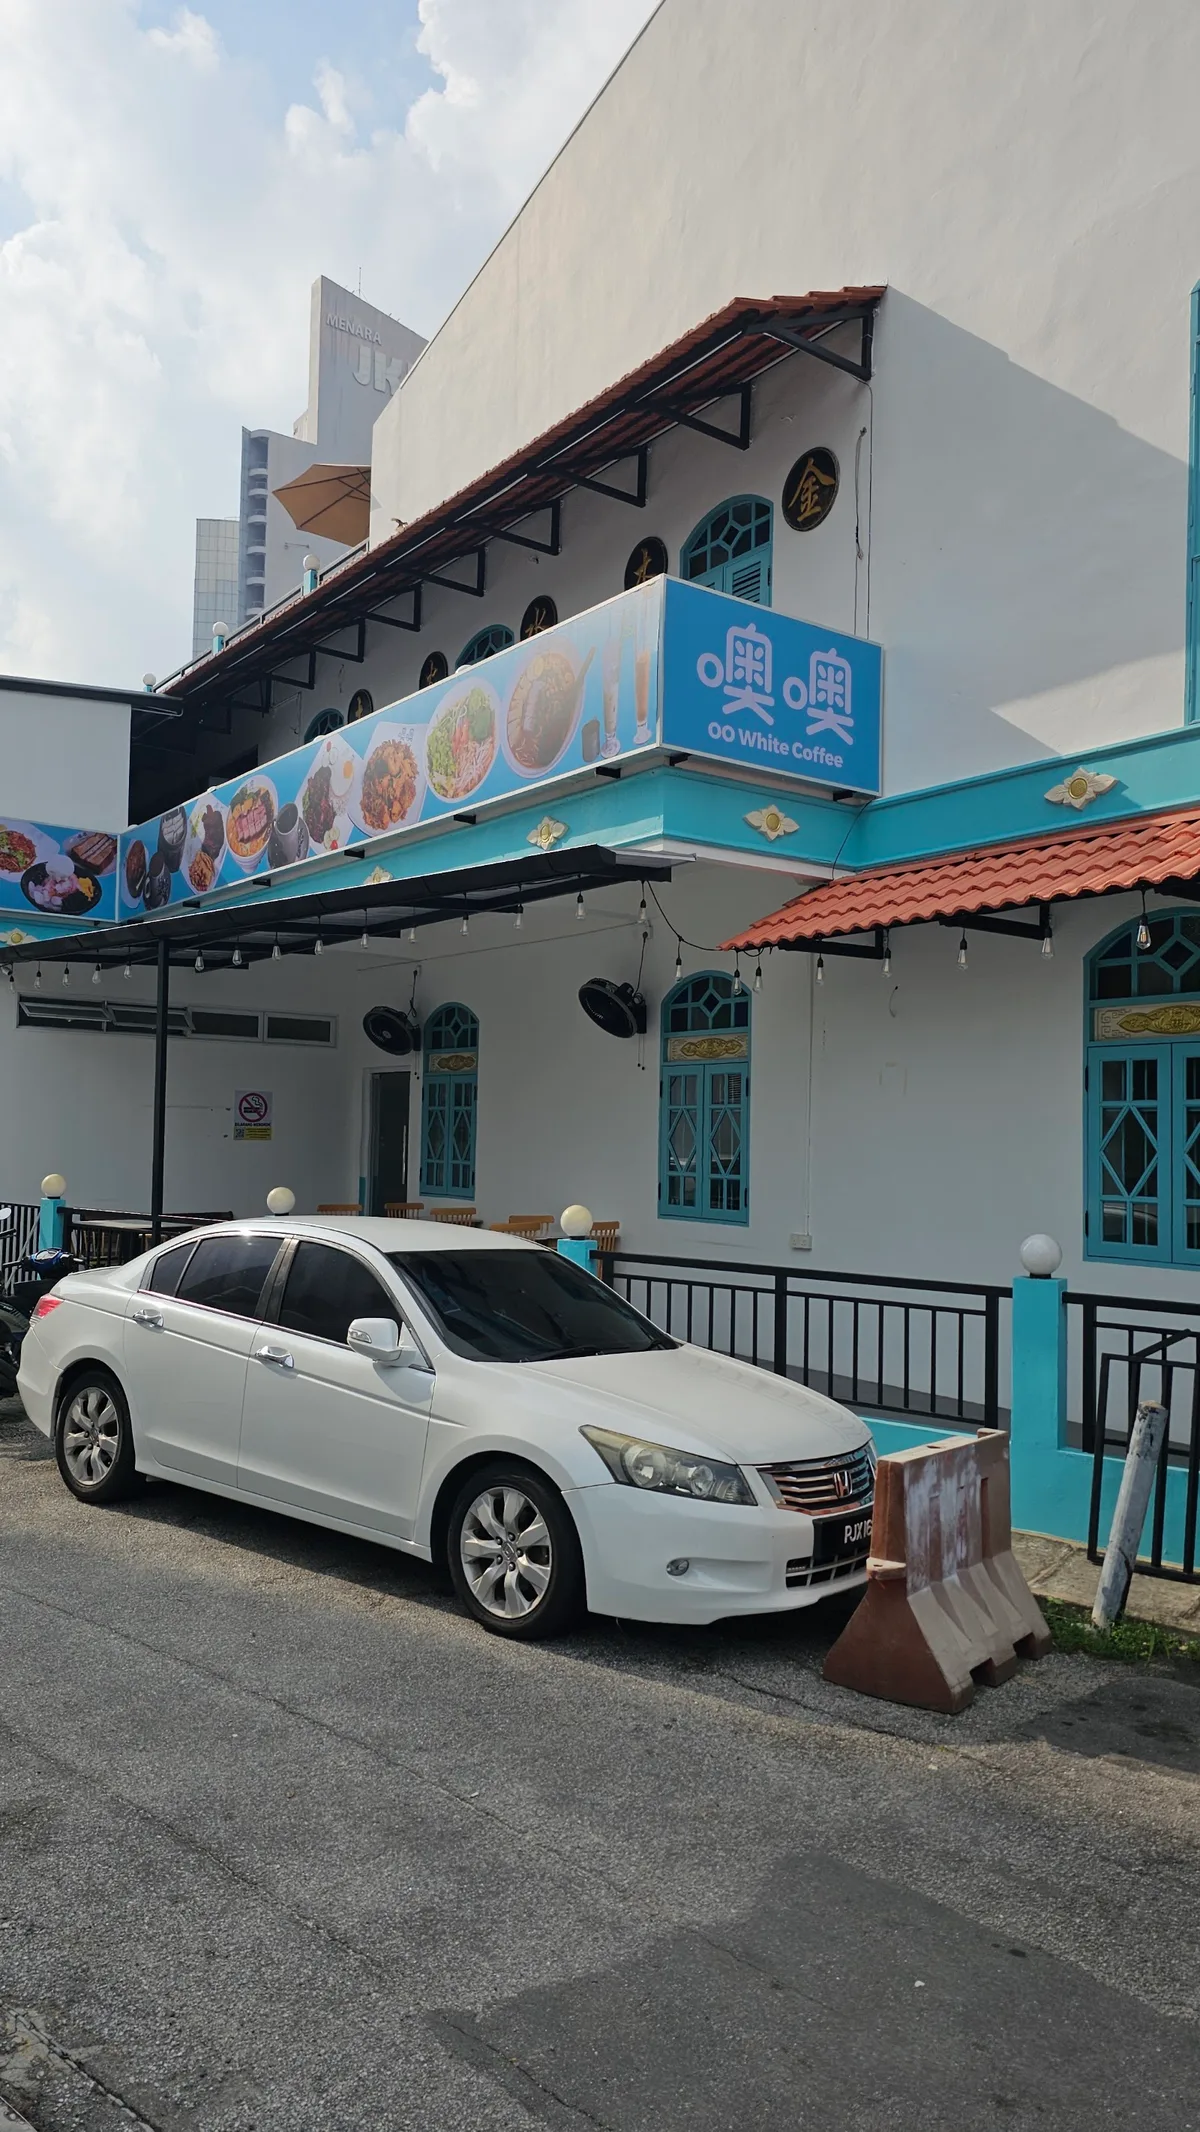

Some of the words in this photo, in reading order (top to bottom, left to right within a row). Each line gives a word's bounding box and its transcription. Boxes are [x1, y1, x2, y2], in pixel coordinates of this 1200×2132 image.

[326, 313, 382, 346] MENARA
[787, 456, 836, 522] 金
[696, 623, 854, 746] 噢噢
[737, 728, 789, 756] White
[791, 742, 844, 769] Coffee
